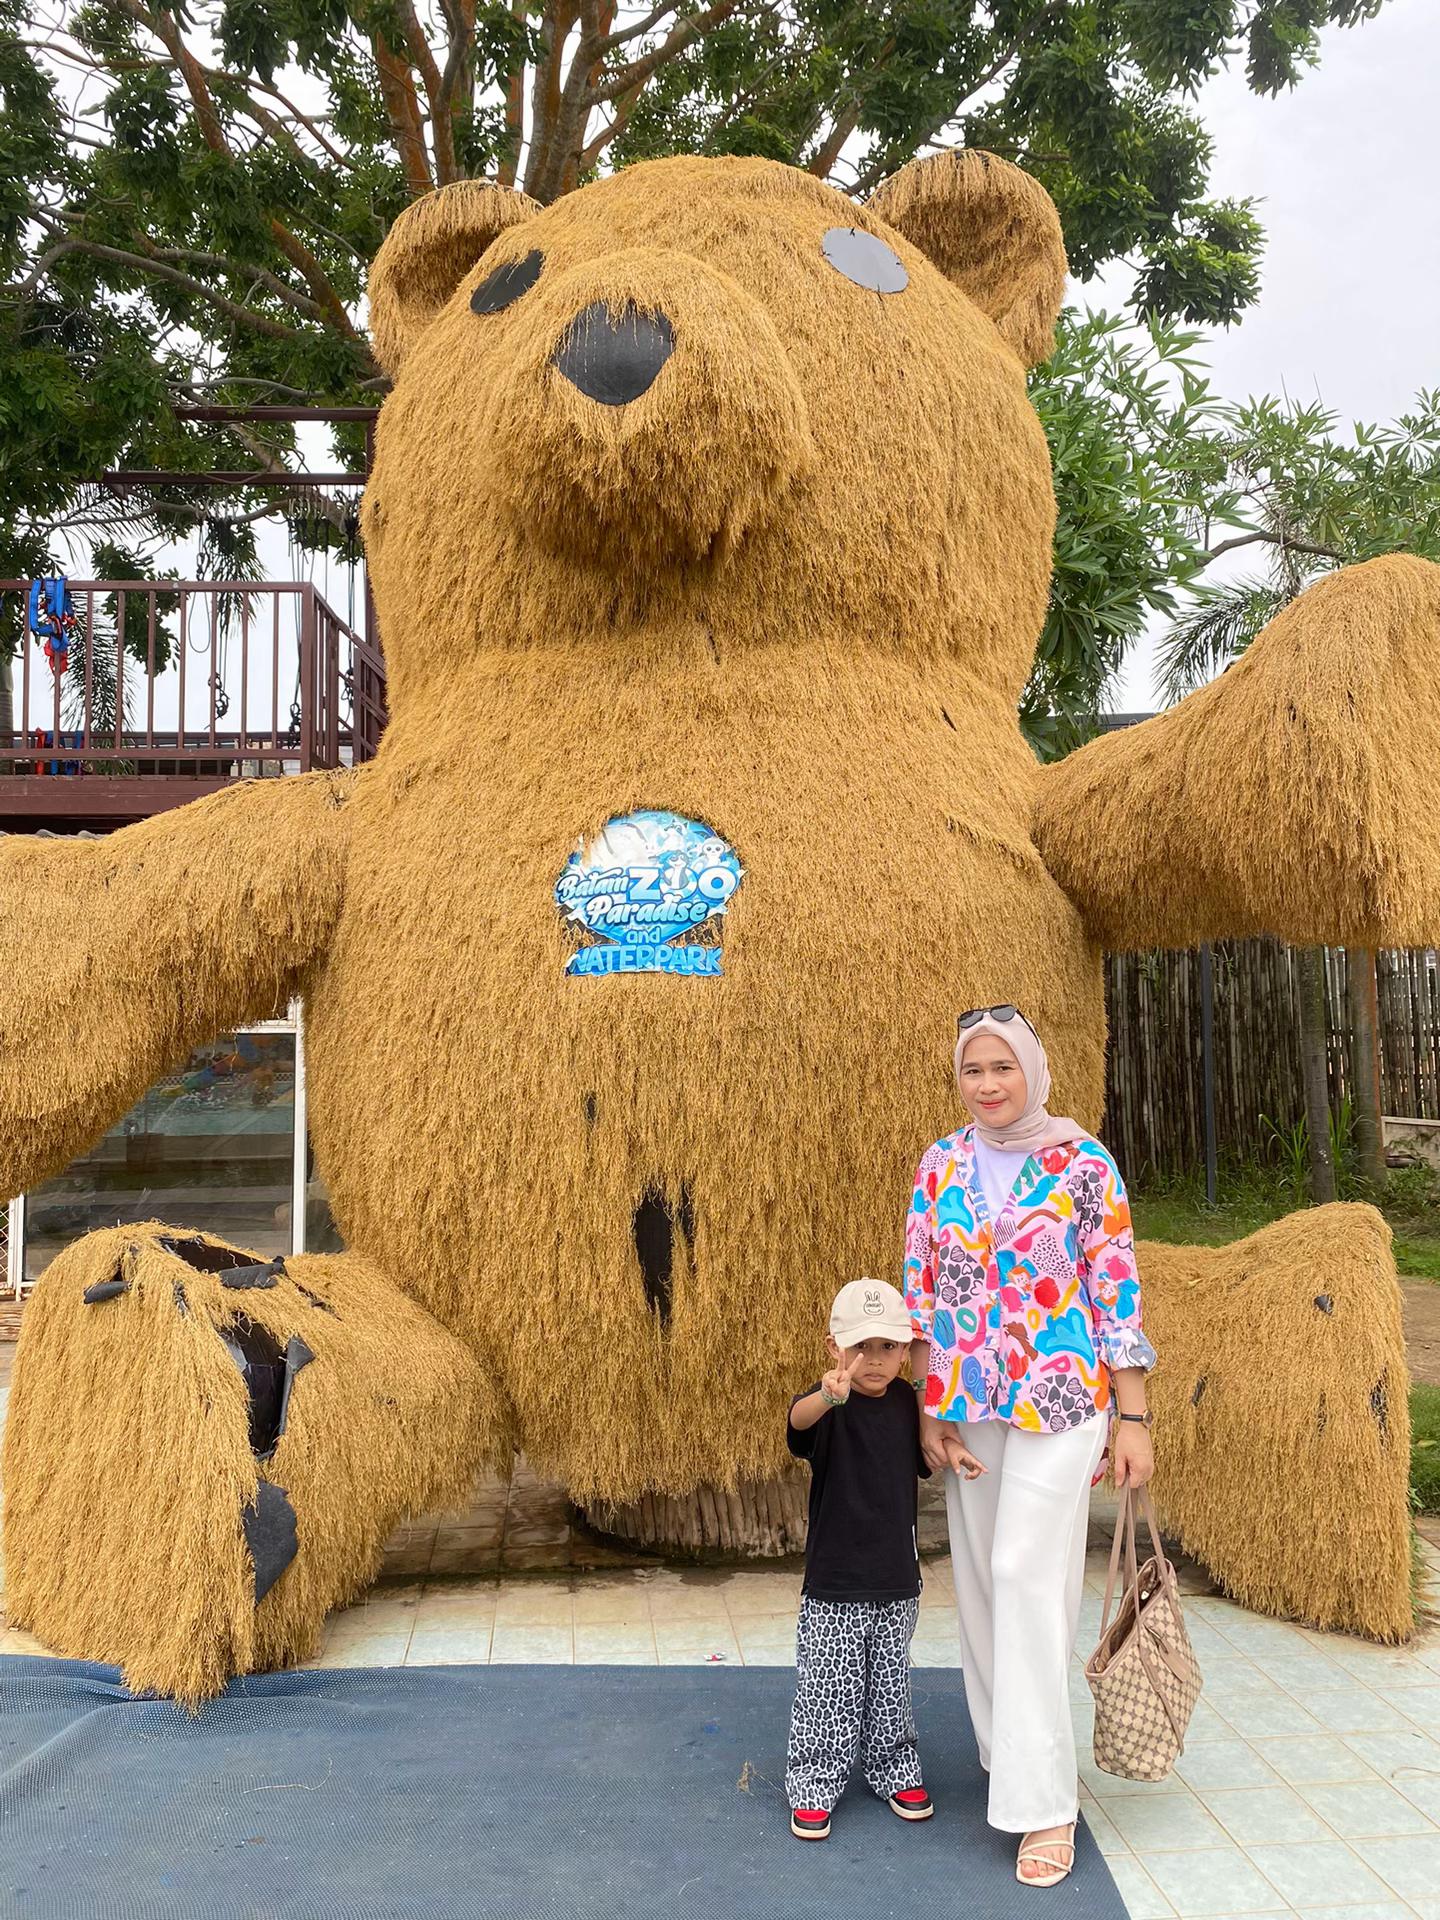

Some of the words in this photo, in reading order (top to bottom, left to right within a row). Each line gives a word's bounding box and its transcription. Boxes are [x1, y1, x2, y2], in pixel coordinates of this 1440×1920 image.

[557, 868, 629, 902] Batam
[629, 866, 737, 901] ZOO
[587, 894, 708, 925] Paradise
[626, 927, 661, 944] and
